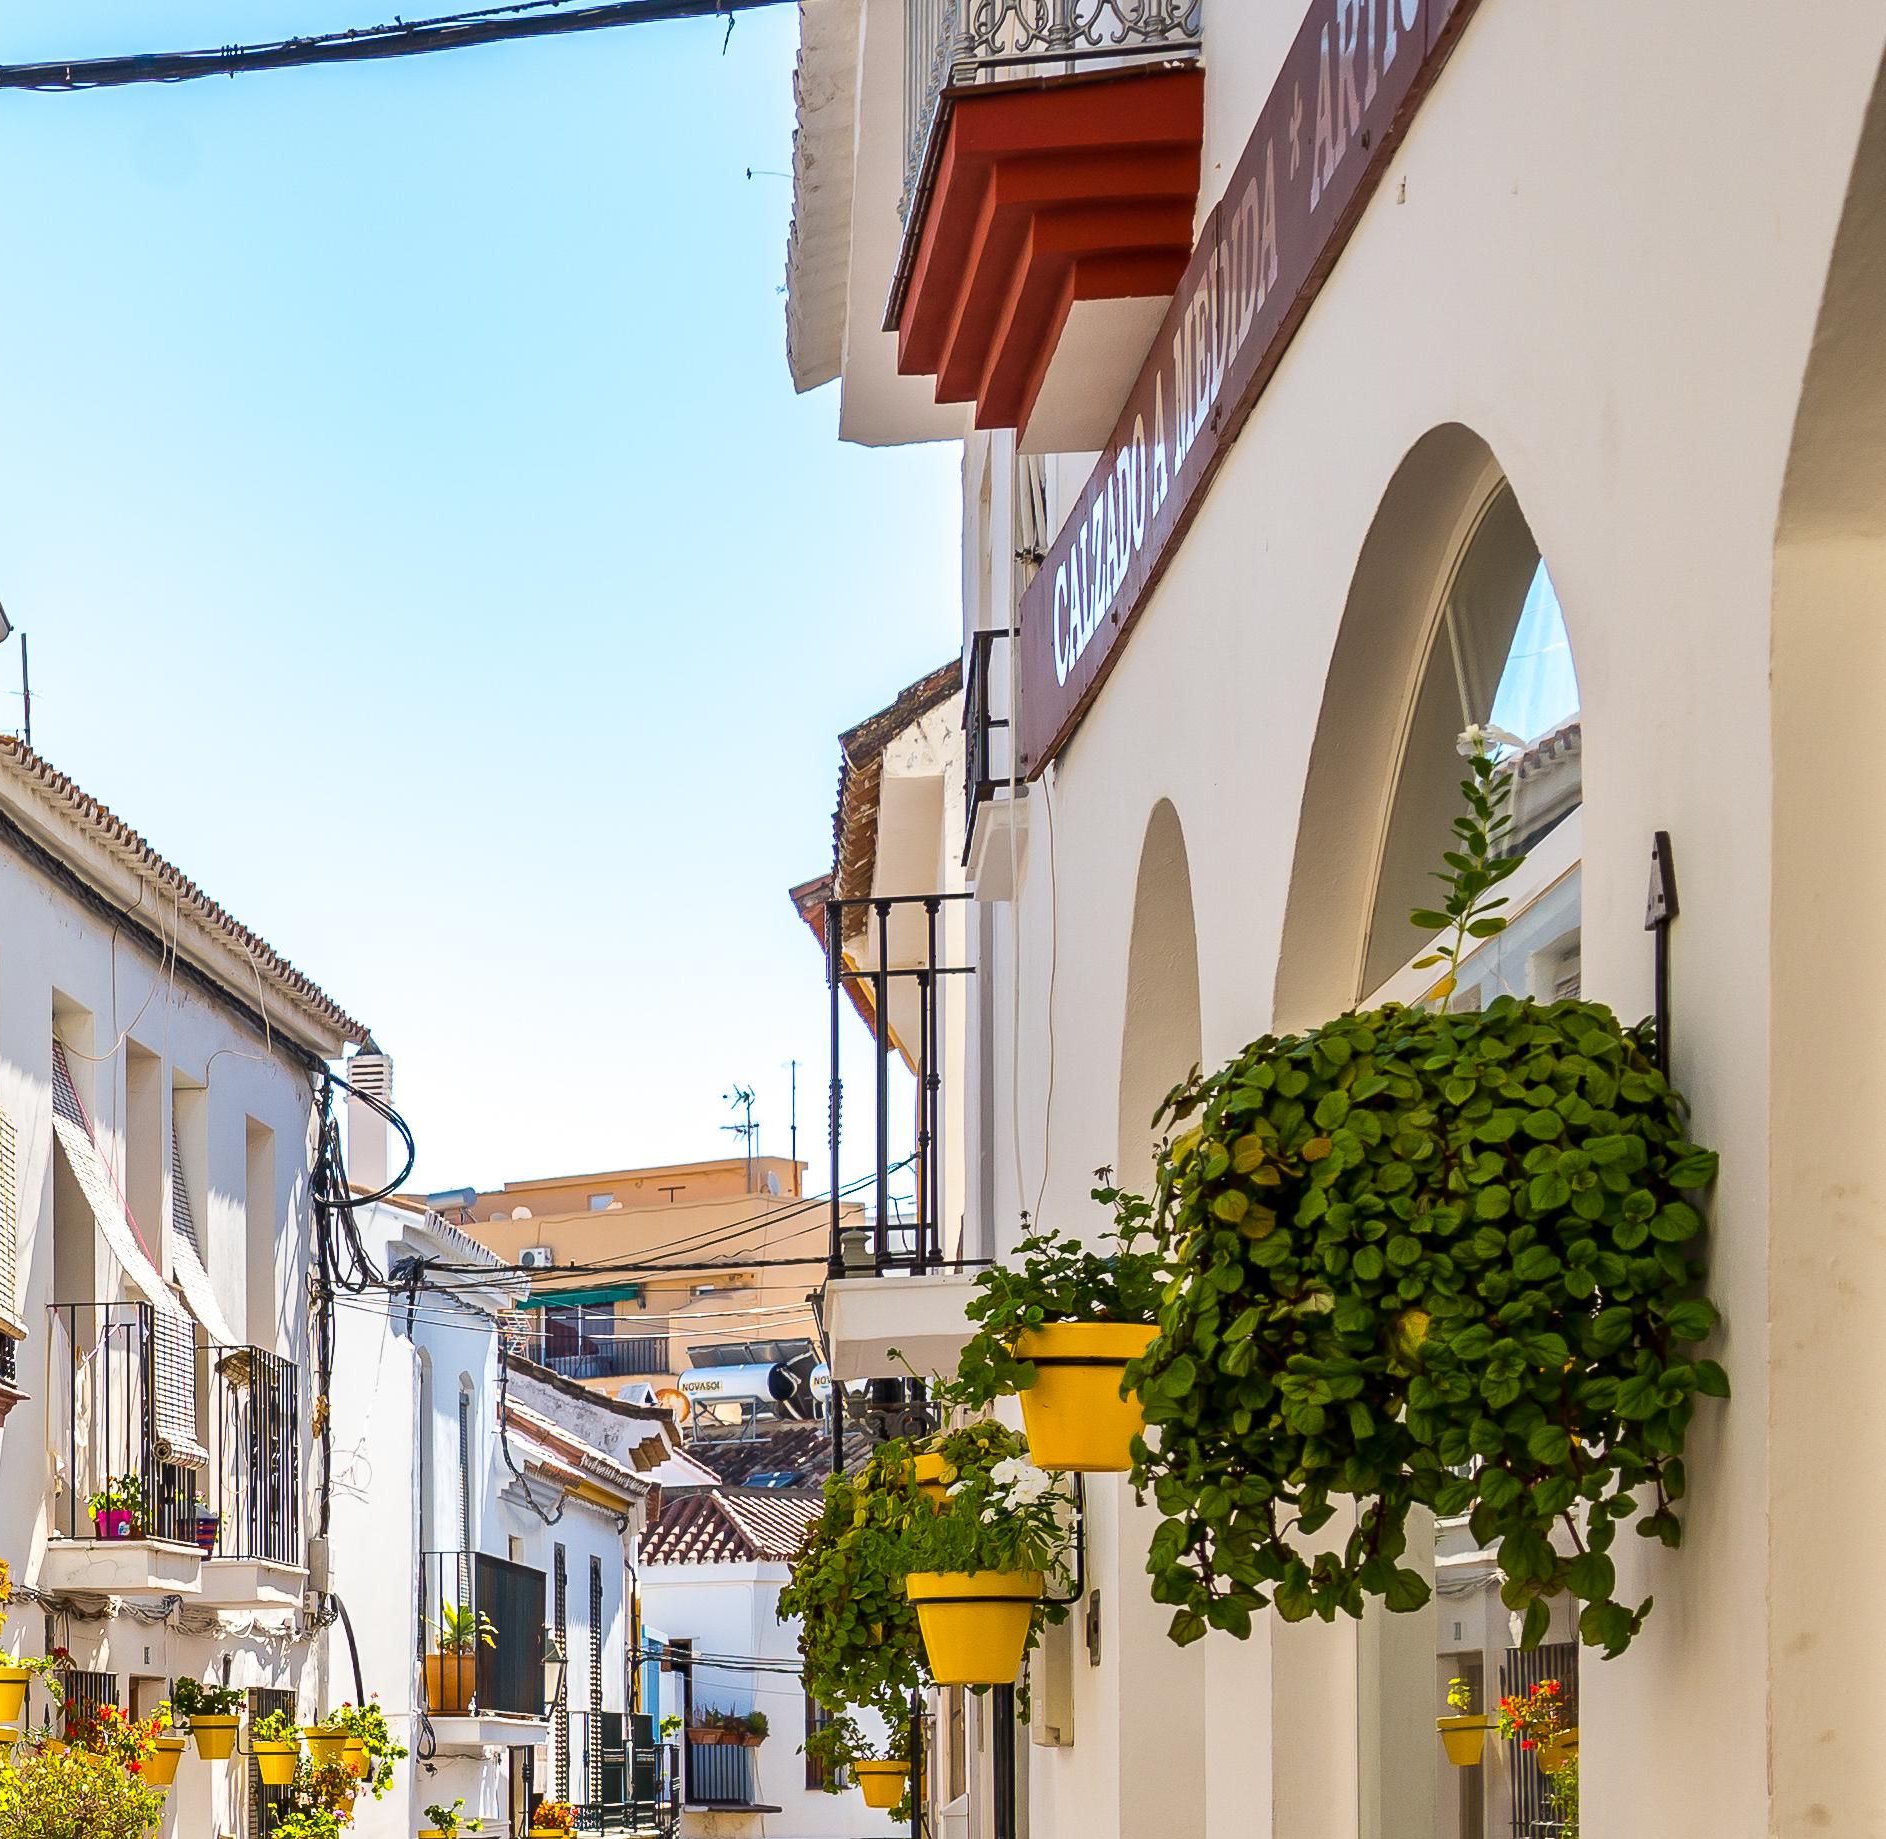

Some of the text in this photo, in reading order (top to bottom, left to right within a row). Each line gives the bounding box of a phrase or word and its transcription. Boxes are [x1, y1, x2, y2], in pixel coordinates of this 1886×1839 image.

[1053, 414, 1146, 687] CALZADO
[1152, 369, 1168, 518] A
[1173, 137, 1278, 477] MEDIDA
